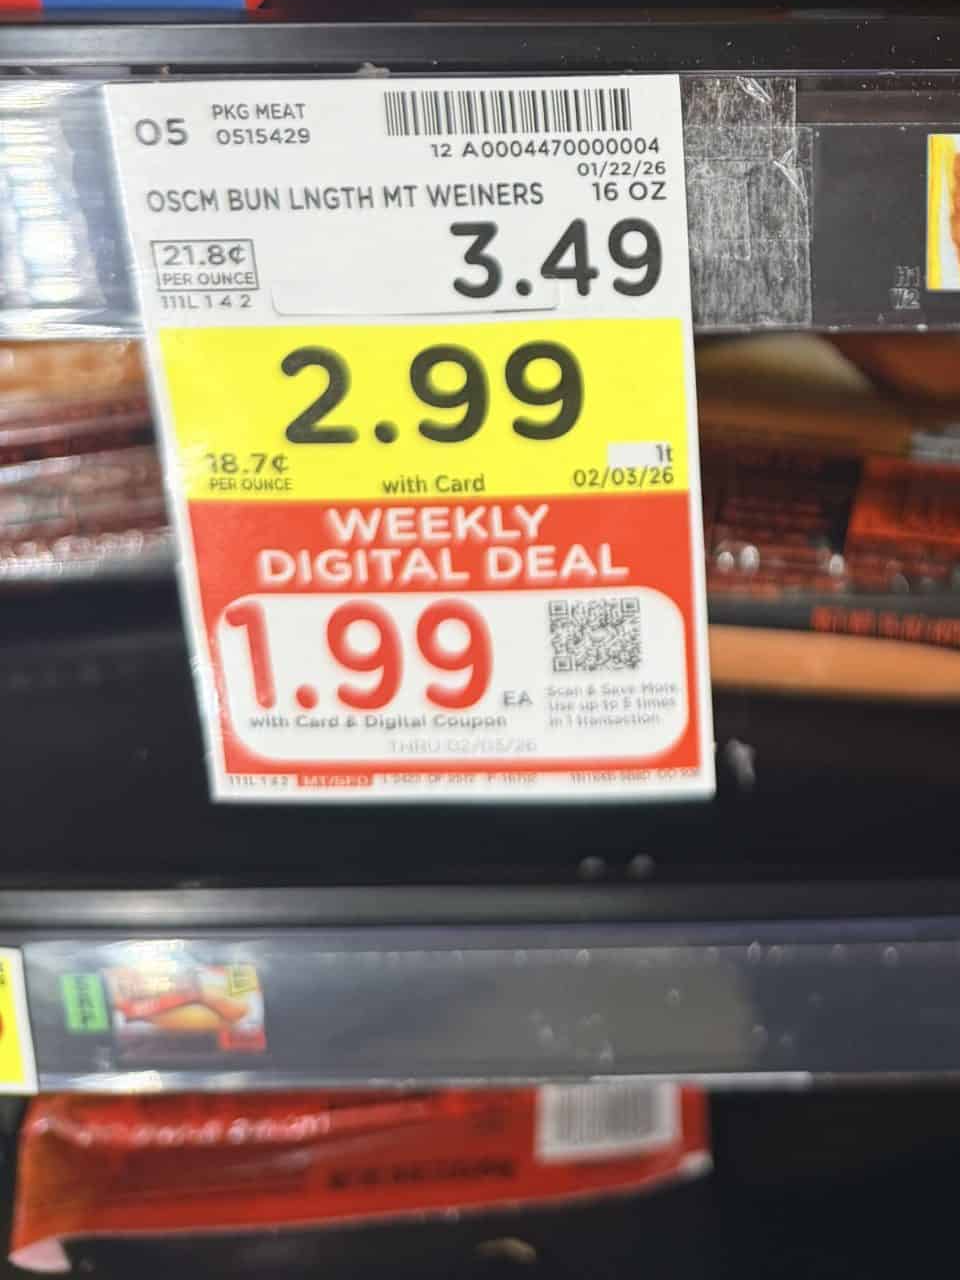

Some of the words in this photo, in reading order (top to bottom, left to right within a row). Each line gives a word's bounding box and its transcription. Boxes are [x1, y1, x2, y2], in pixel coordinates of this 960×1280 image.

[212, 104, 250, 121] PKG
[255, 103, 306, 120] MEAT
[134, 118, 188, 147] 05
[215, 127, 311, 146] 0515429
[431, 142, 453, 158] 12
[462, 137, 661, 159] A0004470000004
[577, 161, 667, 177] 01/22/26
[146, 189, 220, 213] OSCM
[226, 188, 281, 212] BUN
[289, 186, 375, 210] LNGTH
[383, 184, 418, 208] MT
[426, 182, 544, 208] WEINERS
[592, 182, 618, 202] 16
[628, 181, 667, 201] OZ
[163, 243, 246, 267] 21.8¢
[450, 217, 663, 299] 3.49
[162, 272, 193, 287] PER
[196, 271, 256, 286] OUNCE
[205, 295, 213, 309] 1
[220, 295, 232, 308] 4
[240, 294, 252, 308] 2
[279, 339, 586, 446] 2.99
[205, 452, 290, 476] 18.7¢
[655, 444, 673, 464] 1t
[208, 478, 239, 492] PER
[241, 477, 294, 492] OUNCE
[382, 476, 432, 496] with
[435, 474, 487, 494] Card
[572, 466, 675, 490] 02/03/26
[326, 503, 552, 544] WEEKLY
[257, 548, 471, 587] DIGITAL
[485, 543, 631, 583] DEAL
[222, 597, 495, 712] 1.99
[502, 690, 534, 707] EA
[250, 715, 290, 729] with
[295, 714, 340, 729] Card
[365, 713, 427, 731] Digital
[433, 713, 508, 730] Coupon
